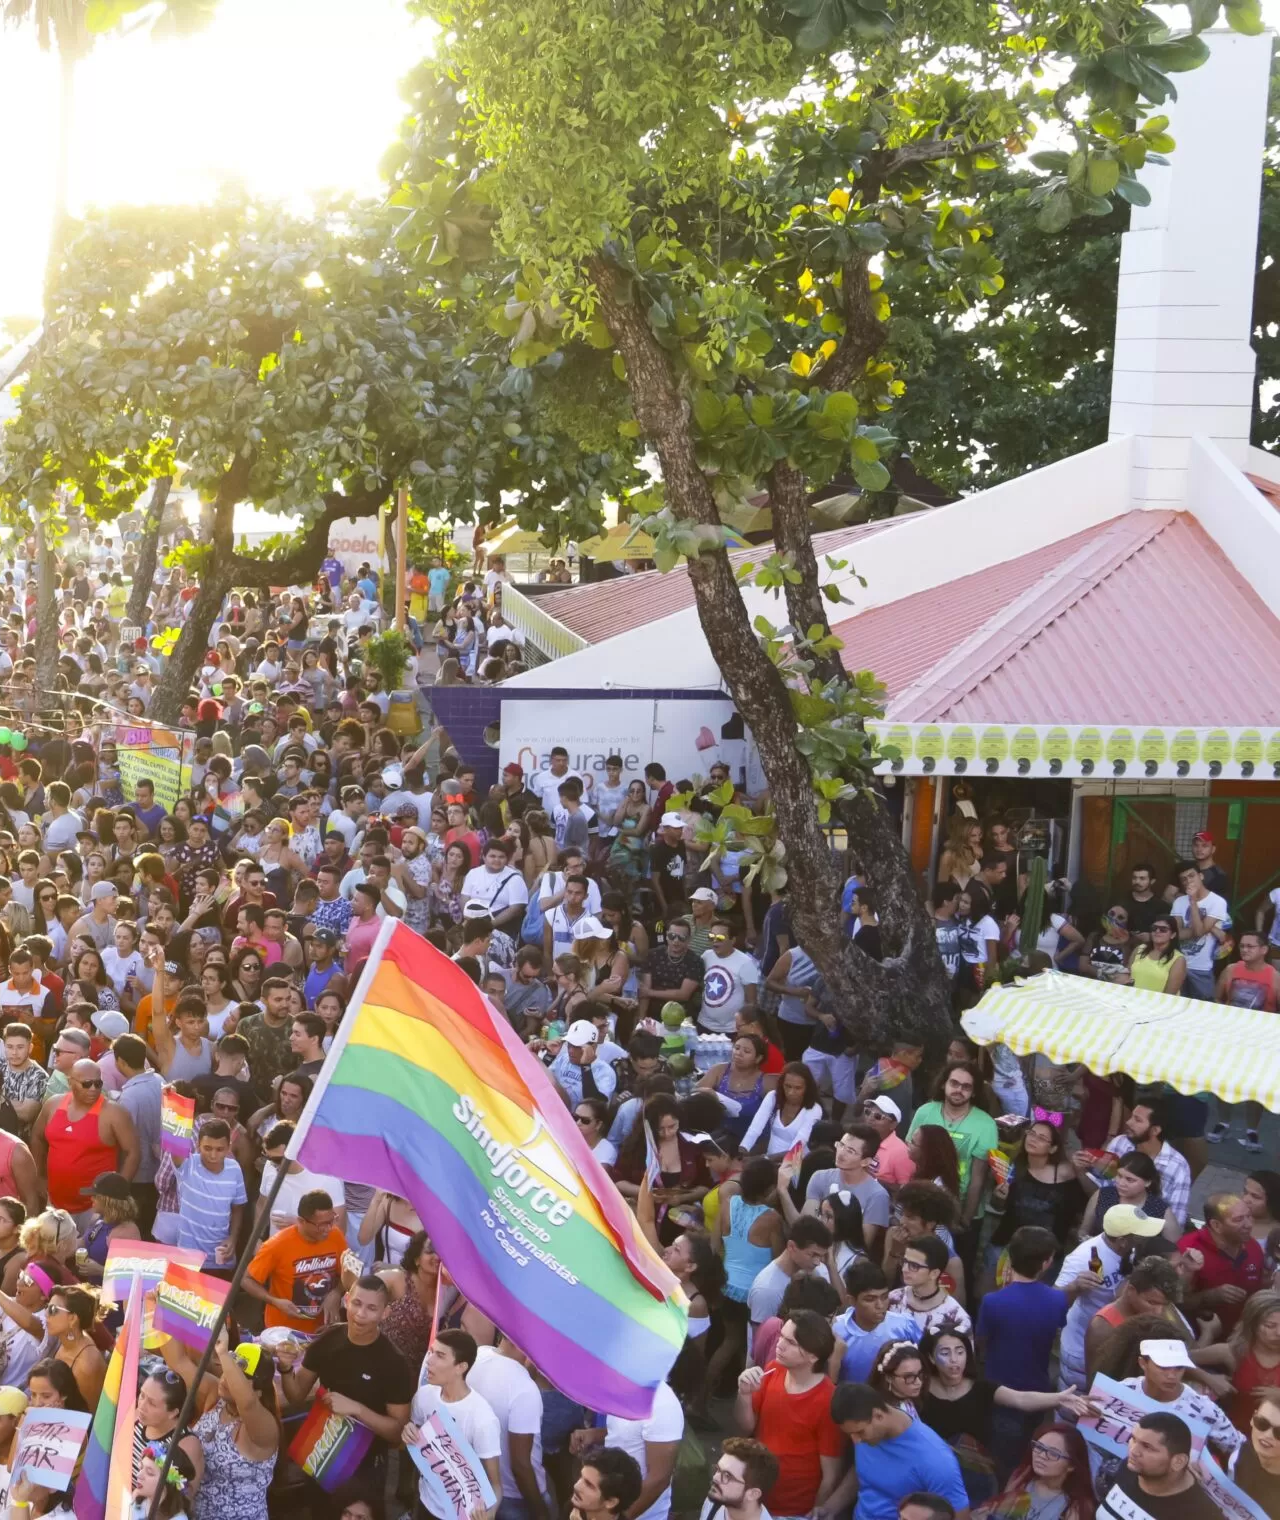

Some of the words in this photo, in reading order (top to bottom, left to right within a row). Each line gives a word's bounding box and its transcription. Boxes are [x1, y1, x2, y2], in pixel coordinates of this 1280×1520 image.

[330, 535, 380, 553] coelc
[518, 747, 640, 771] naurae
[591, 1032, 597, 1041] 3
[452, 1094, 575, 1227] Sindjorce
[493, 1186, 552, 1244] Sindicato
[480, 1209, 495, 1229] no
[494, 1228, 532, 1268] Ceará
[488, 1198, 508, 1225] dos
[507, 1224, 580, 1286] Jornalistas
[295, 1256, 337, 1274] Hollister
[420, 1443, 434, 1459] E
